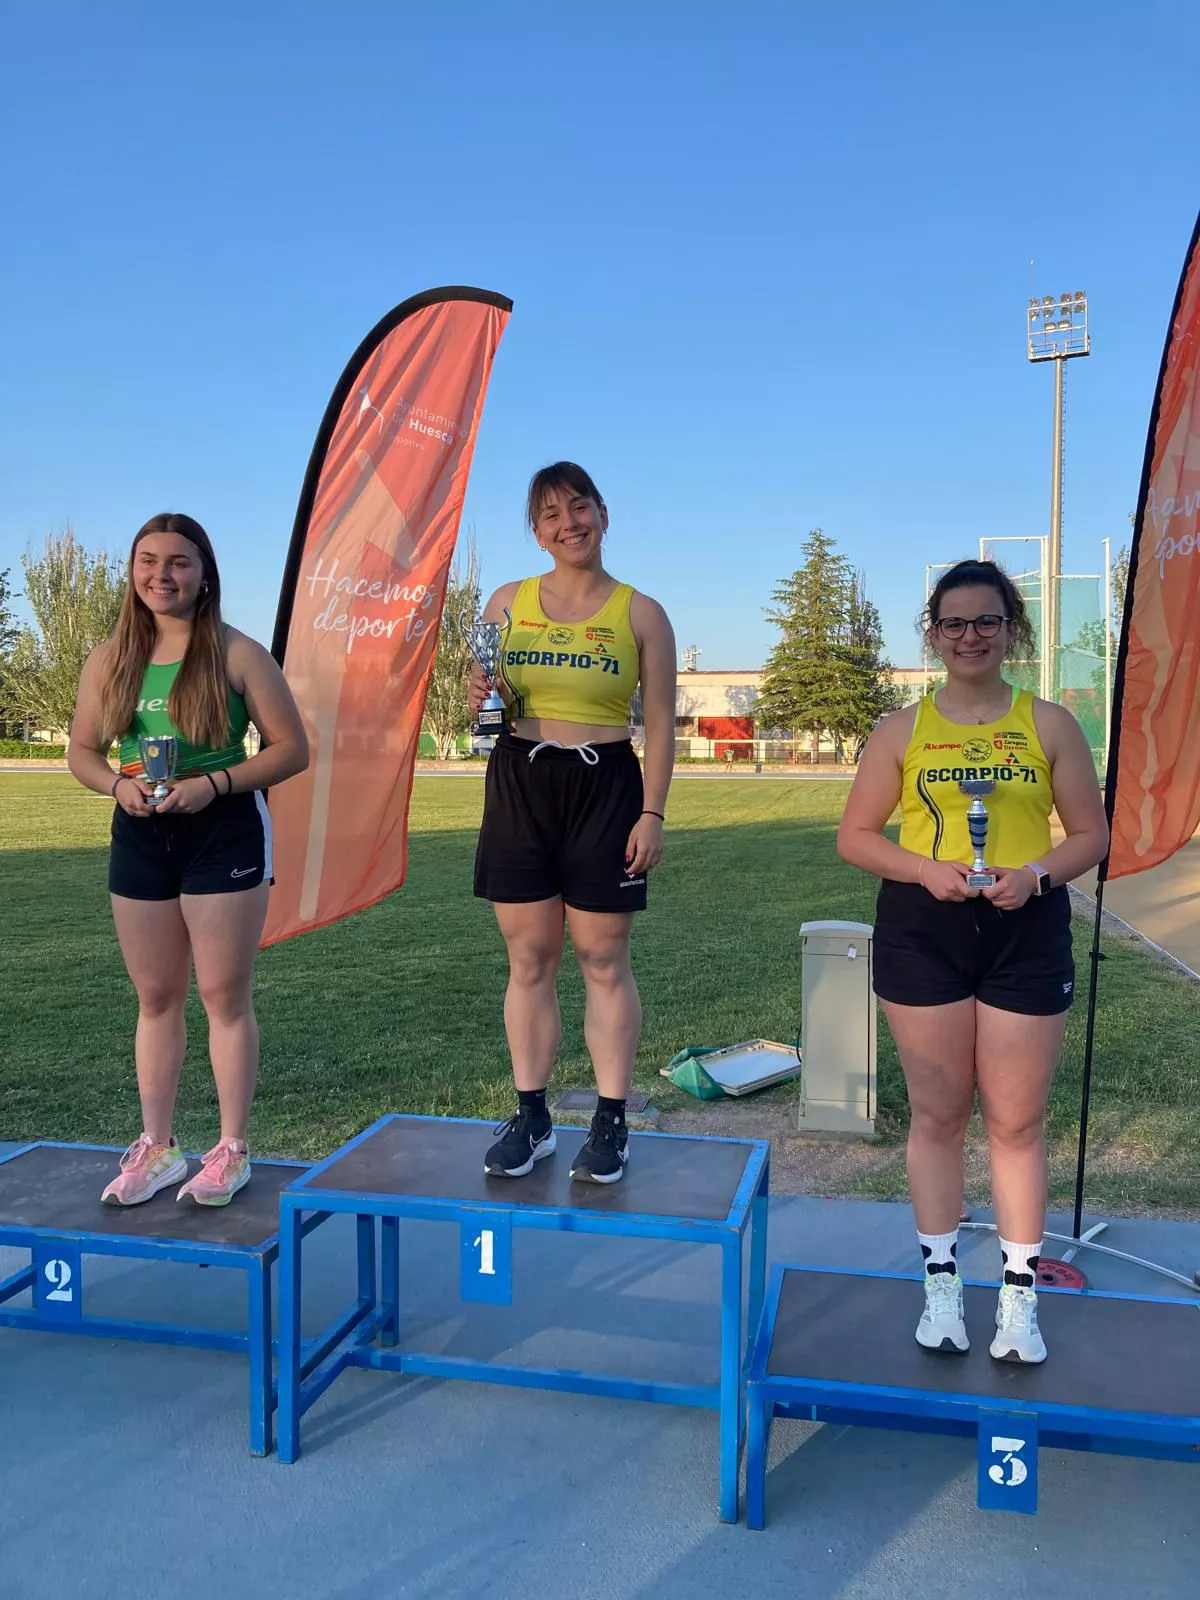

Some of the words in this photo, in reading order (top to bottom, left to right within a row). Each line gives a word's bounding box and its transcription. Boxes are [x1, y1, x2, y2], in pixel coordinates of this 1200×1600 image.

[409, 417, 453, 444] Huesca
[306, 558, 437, 608] Hacemos
[313, 597, 425, 653] deporte
[506, 650, 619, 675] SCORPIO-71
[926, 767, 1037, 783] SCORPIO-71
[474, 1230, 496, 1274] 1
[44, 1259, 73, 1302] 2
[988, 1436, 1028, 1486] 3
